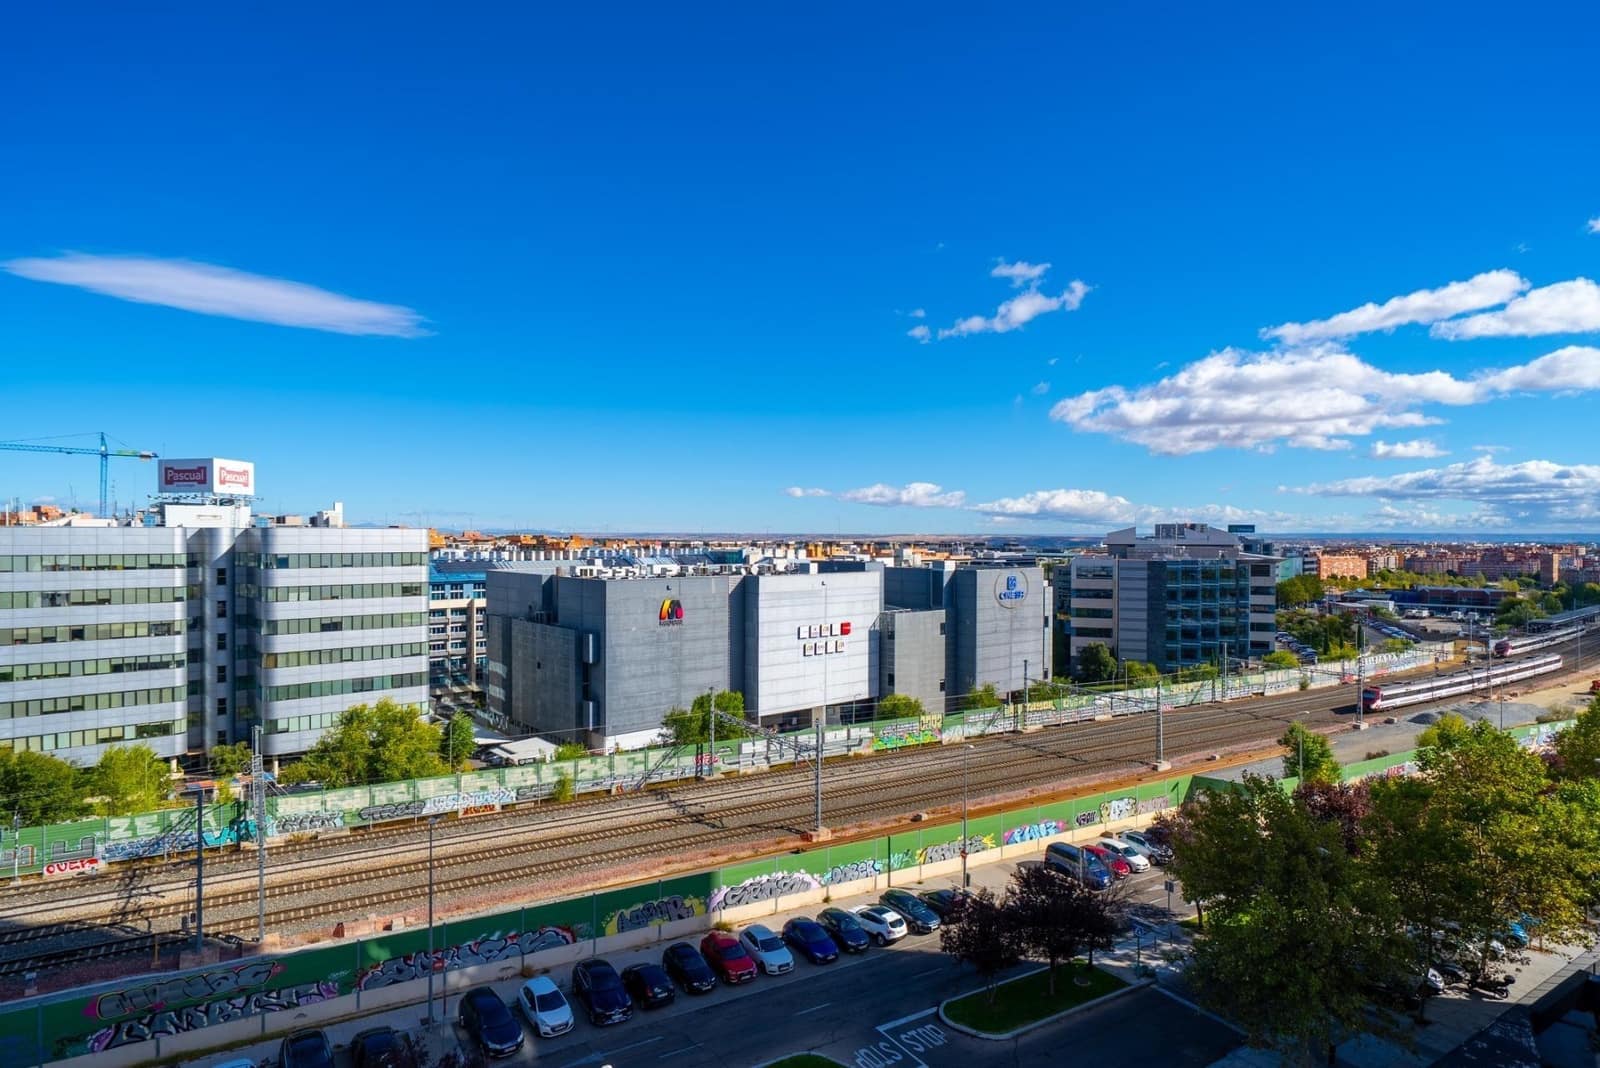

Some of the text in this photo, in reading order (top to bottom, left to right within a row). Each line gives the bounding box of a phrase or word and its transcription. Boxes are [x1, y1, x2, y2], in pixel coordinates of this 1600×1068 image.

[167, 469, 204, 481] Pascual
[221, 469, 248, 482] Pascual
[901, 1024, 947, 1052] STOP
